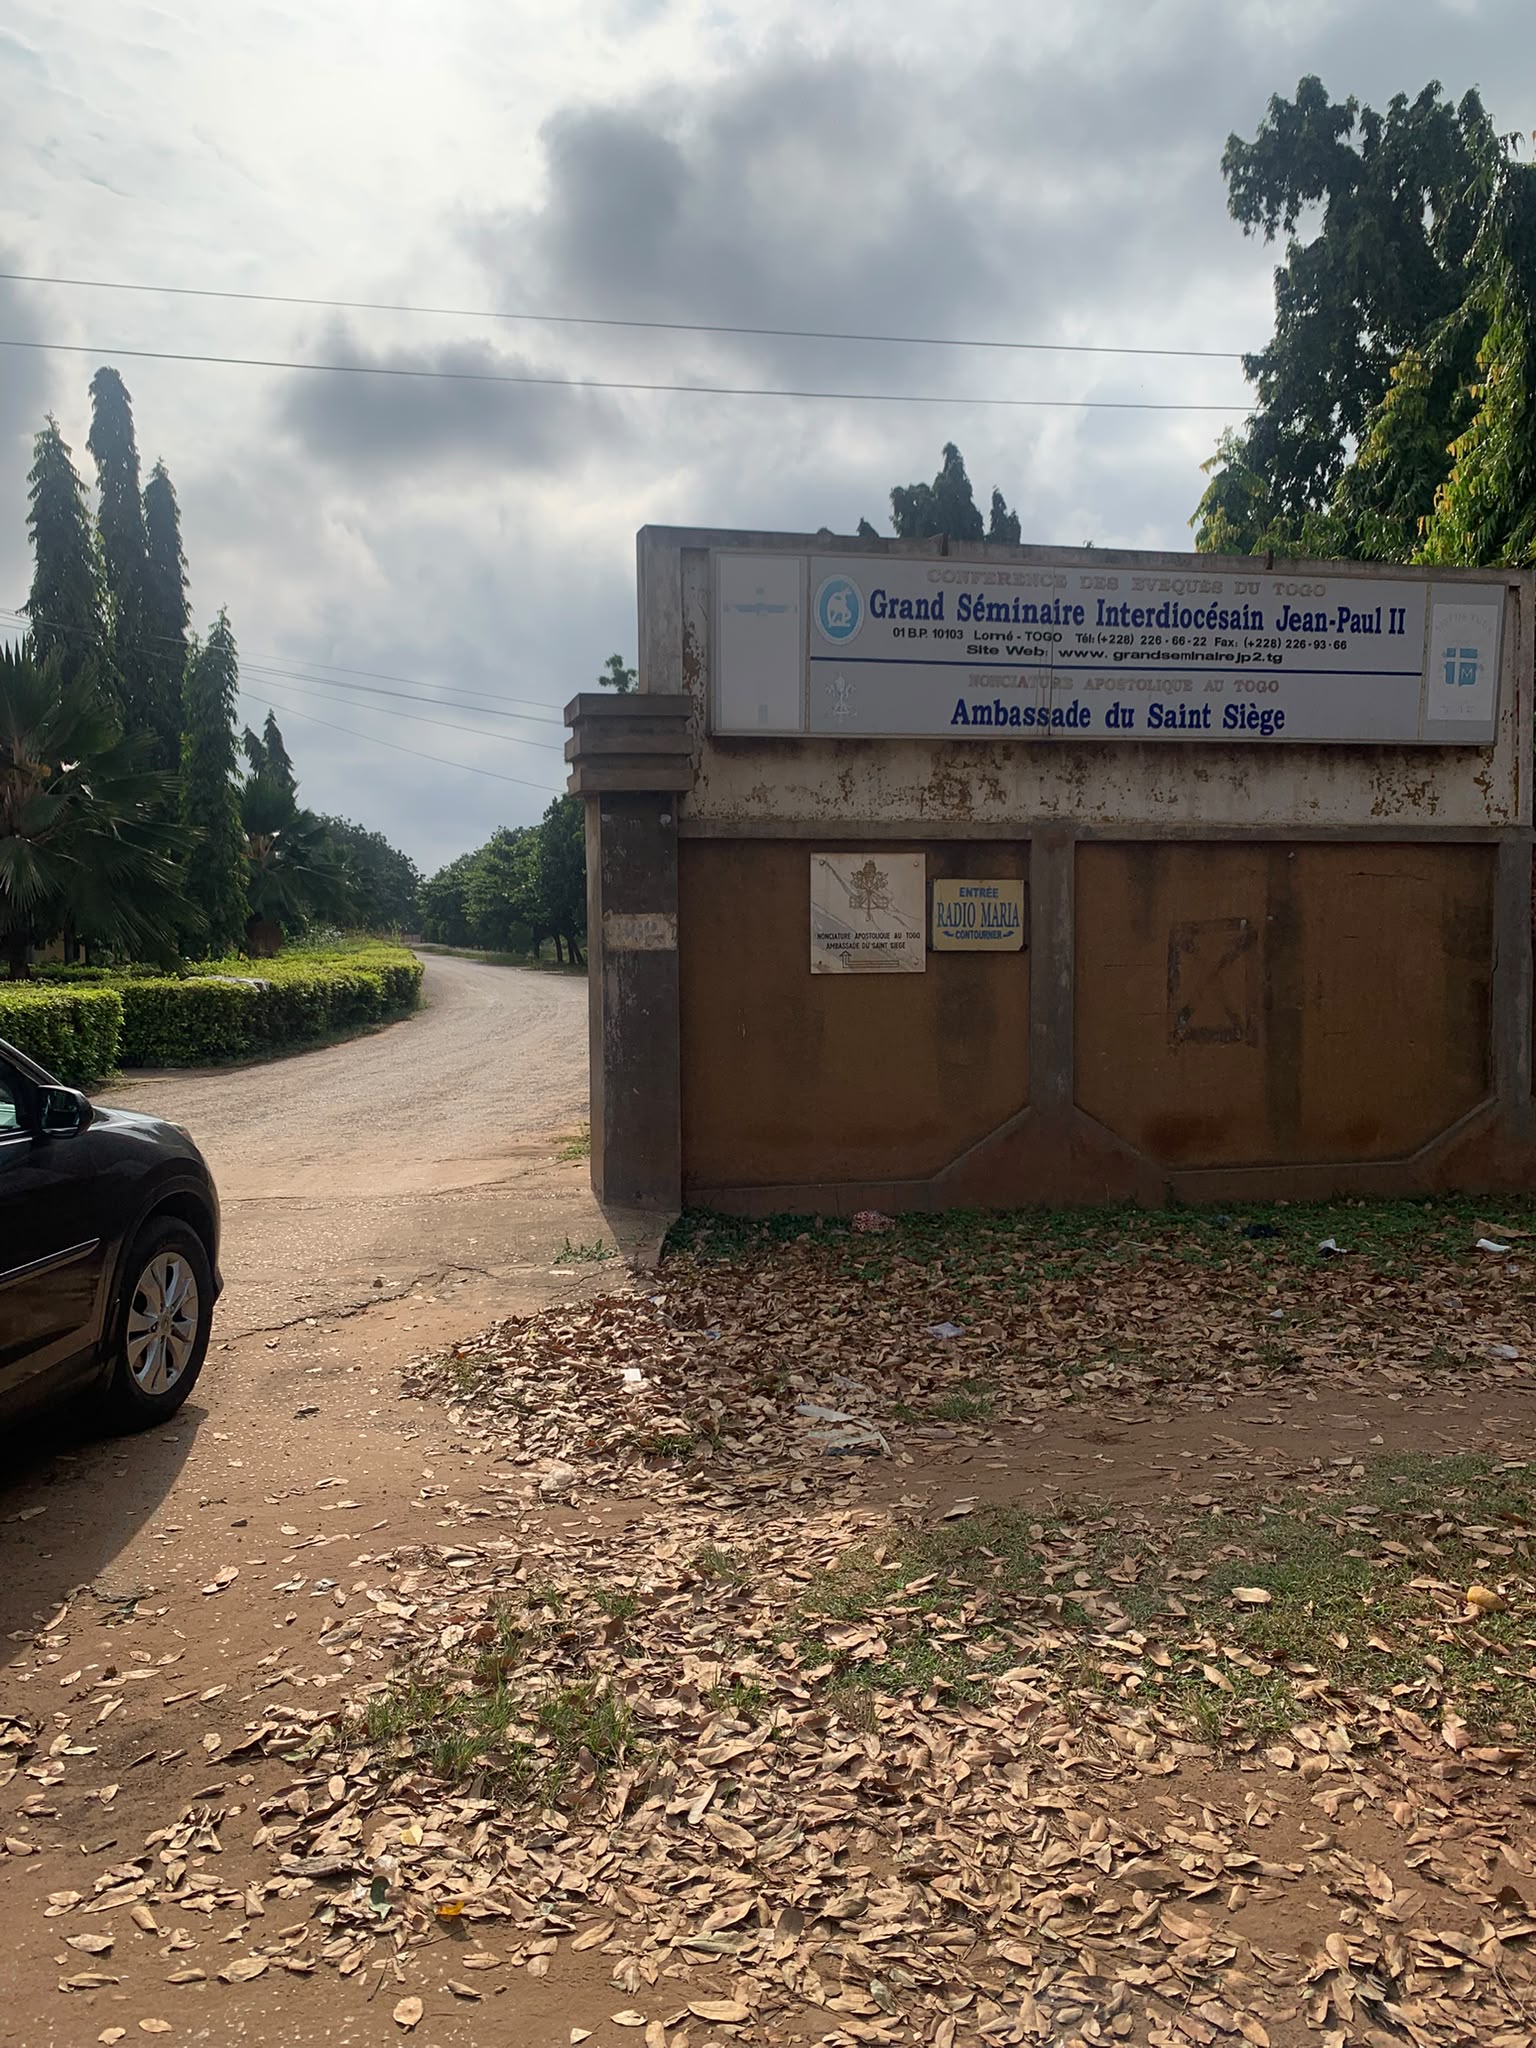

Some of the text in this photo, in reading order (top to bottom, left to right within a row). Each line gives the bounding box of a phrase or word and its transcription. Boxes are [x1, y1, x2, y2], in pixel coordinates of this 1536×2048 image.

[927, 569, 1067, 588] CONFERENCE
[1080, 575, 1119, 591] DES
[1234, 581, 1261, 595] DU
[1273, 583, 1326, 597] TOGO
[870, 589, 944, 621] Grand
[957, 593, 1085, 625] Séminaire
[1096, 599, 1264, 630] Interdiocésain
[1276, 605, 1382, 634] Jean-Paul
[1389, 608, 1406, 635] II
[893, 627, 905, 638] 01
[932, 628, 963, 640] 10103
[974, 630, 1013, 641] Lomé
[1025, 631, 1063, 643] TOGO
[1244, 637, 1281, 649] (+228)
[966, 644, 999, 655] Site
[1005, 645, 1048, 657] Web:
[968, 674, 1279, 694] NONCIATURE APOSTOLIQUE AU TOGO
[951, 698, 1285, 736] Ambassade du Saint Siège
[937, 902, 1019, 928] RADIO MARIA
[817, 932, 850, 940] NONCIATURE
[854, 932, 890, 940] APOSTOLIQUE
[906, 931, 920, 939] TOGO
[955, 930, 1002, 939] CONTOURNER
